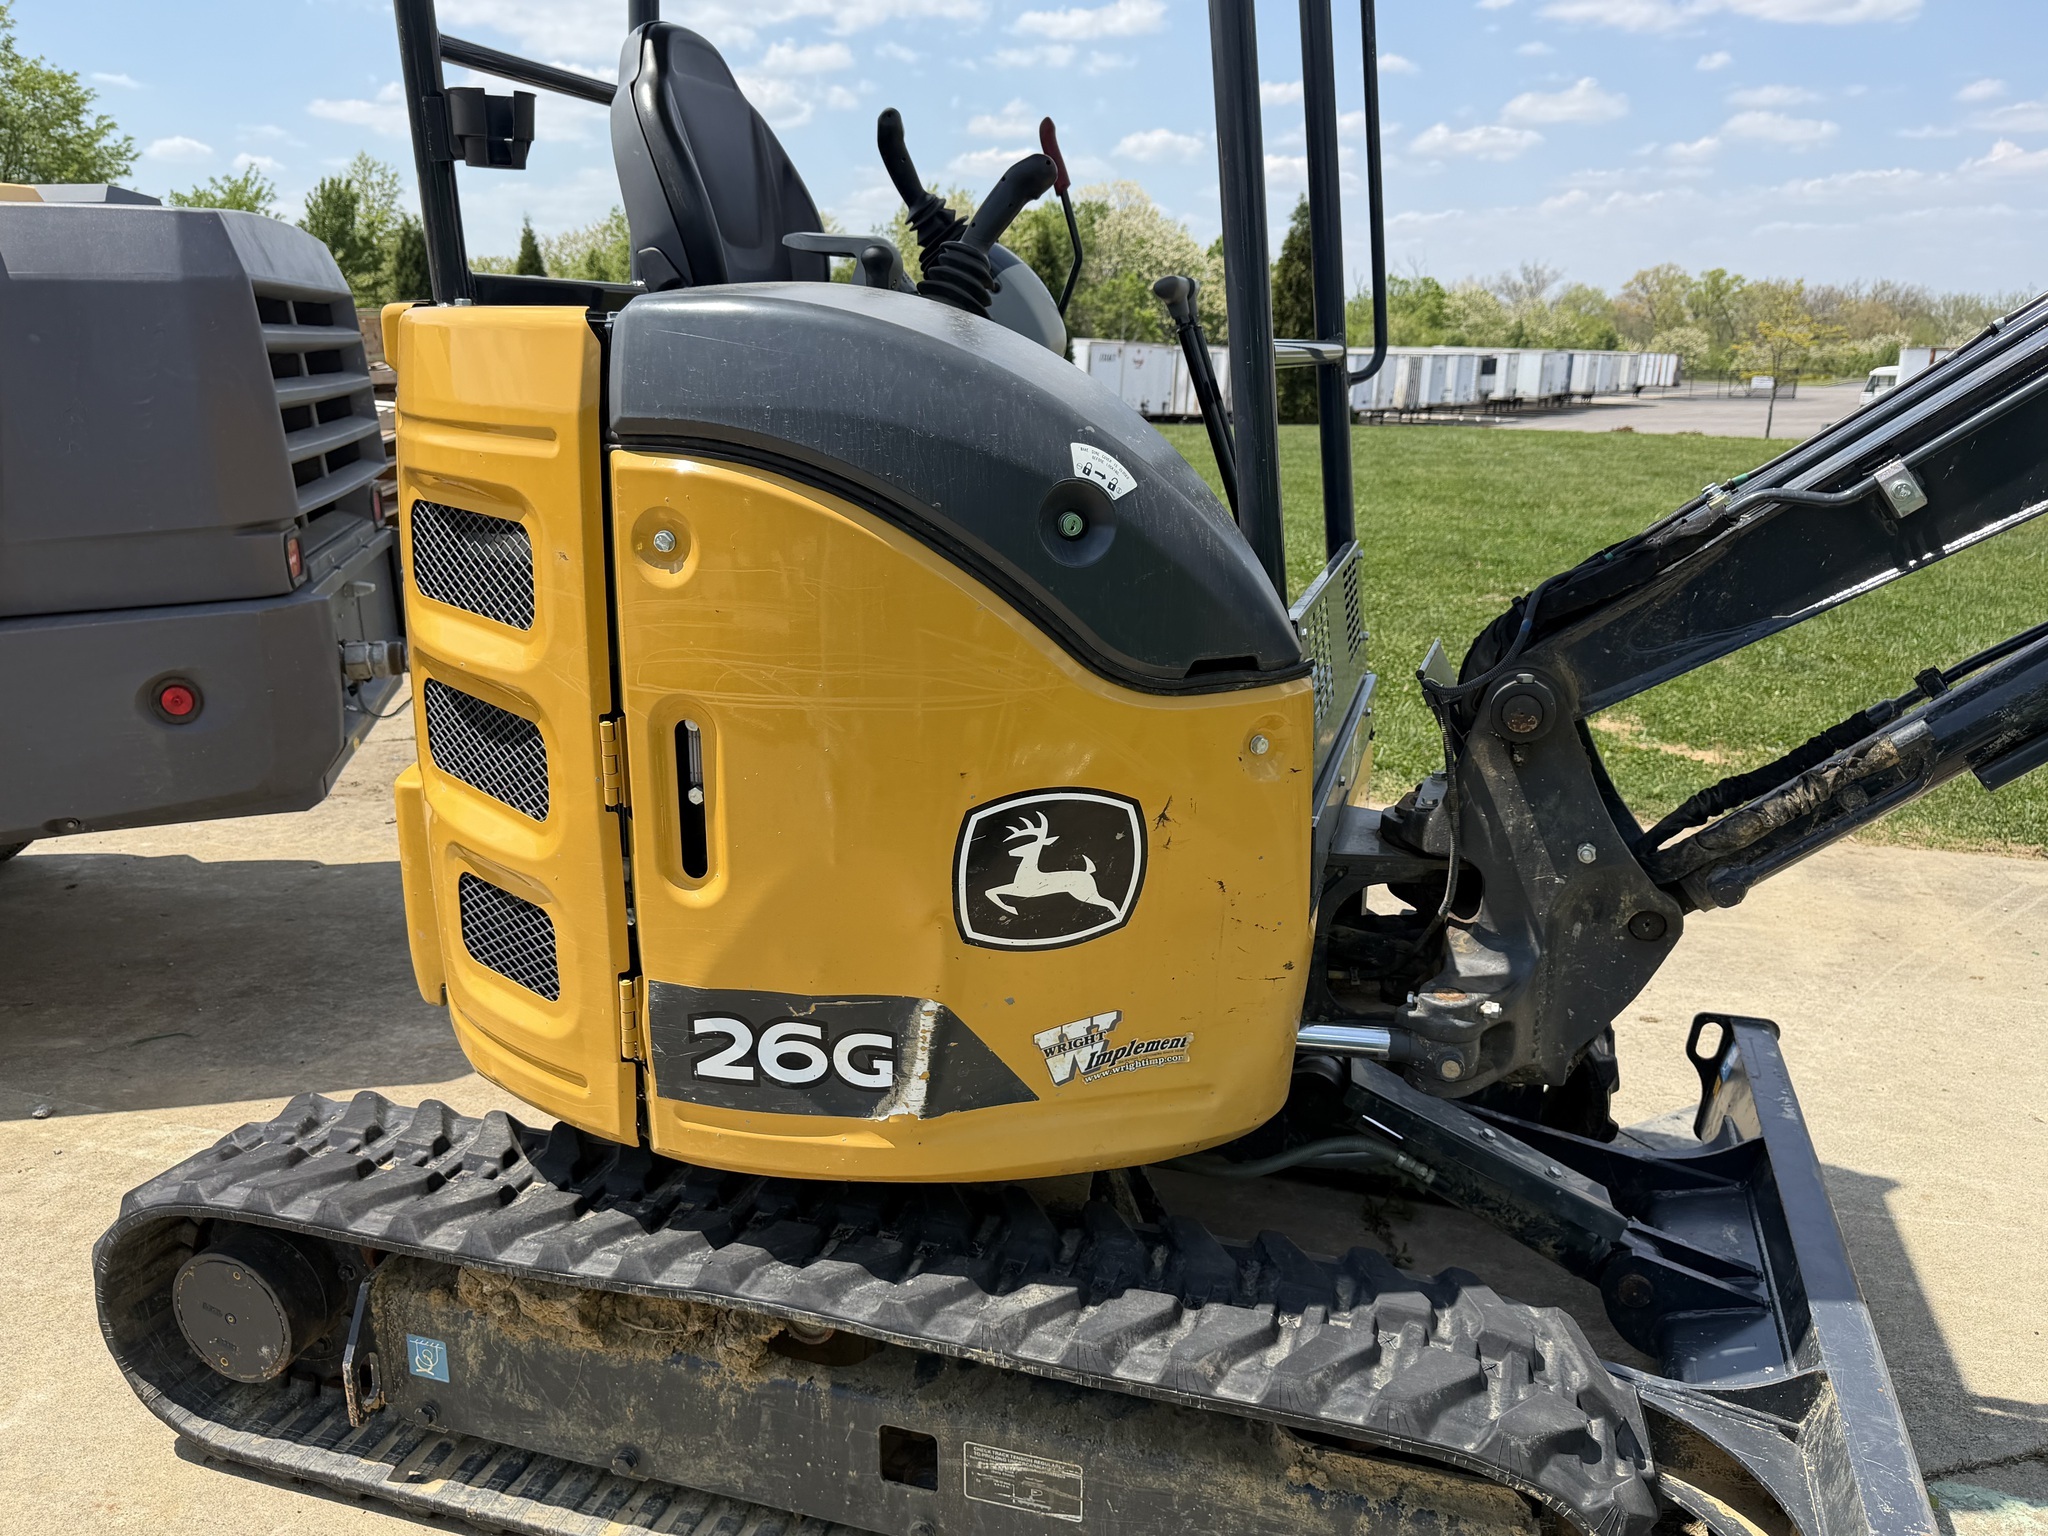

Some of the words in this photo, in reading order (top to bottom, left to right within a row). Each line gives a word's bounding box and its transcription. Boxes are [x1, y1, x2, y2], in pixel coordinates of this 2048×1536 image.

[694, 1017, 893, 1088] 26G
[1043, 1030, 1107, 1058] WRIGHT
[1084, 1036, 1188, 1071] Implement
[973, 1446, 992, 1455] CHECK
[992, 1450, 1009, 1459] TRACK
[1010, 1454, 1034, 1464] TENSION
[1034, 1458, 1066, 1470] REGULARLY
[981, 1452, 1007, 1462] PROLONG
